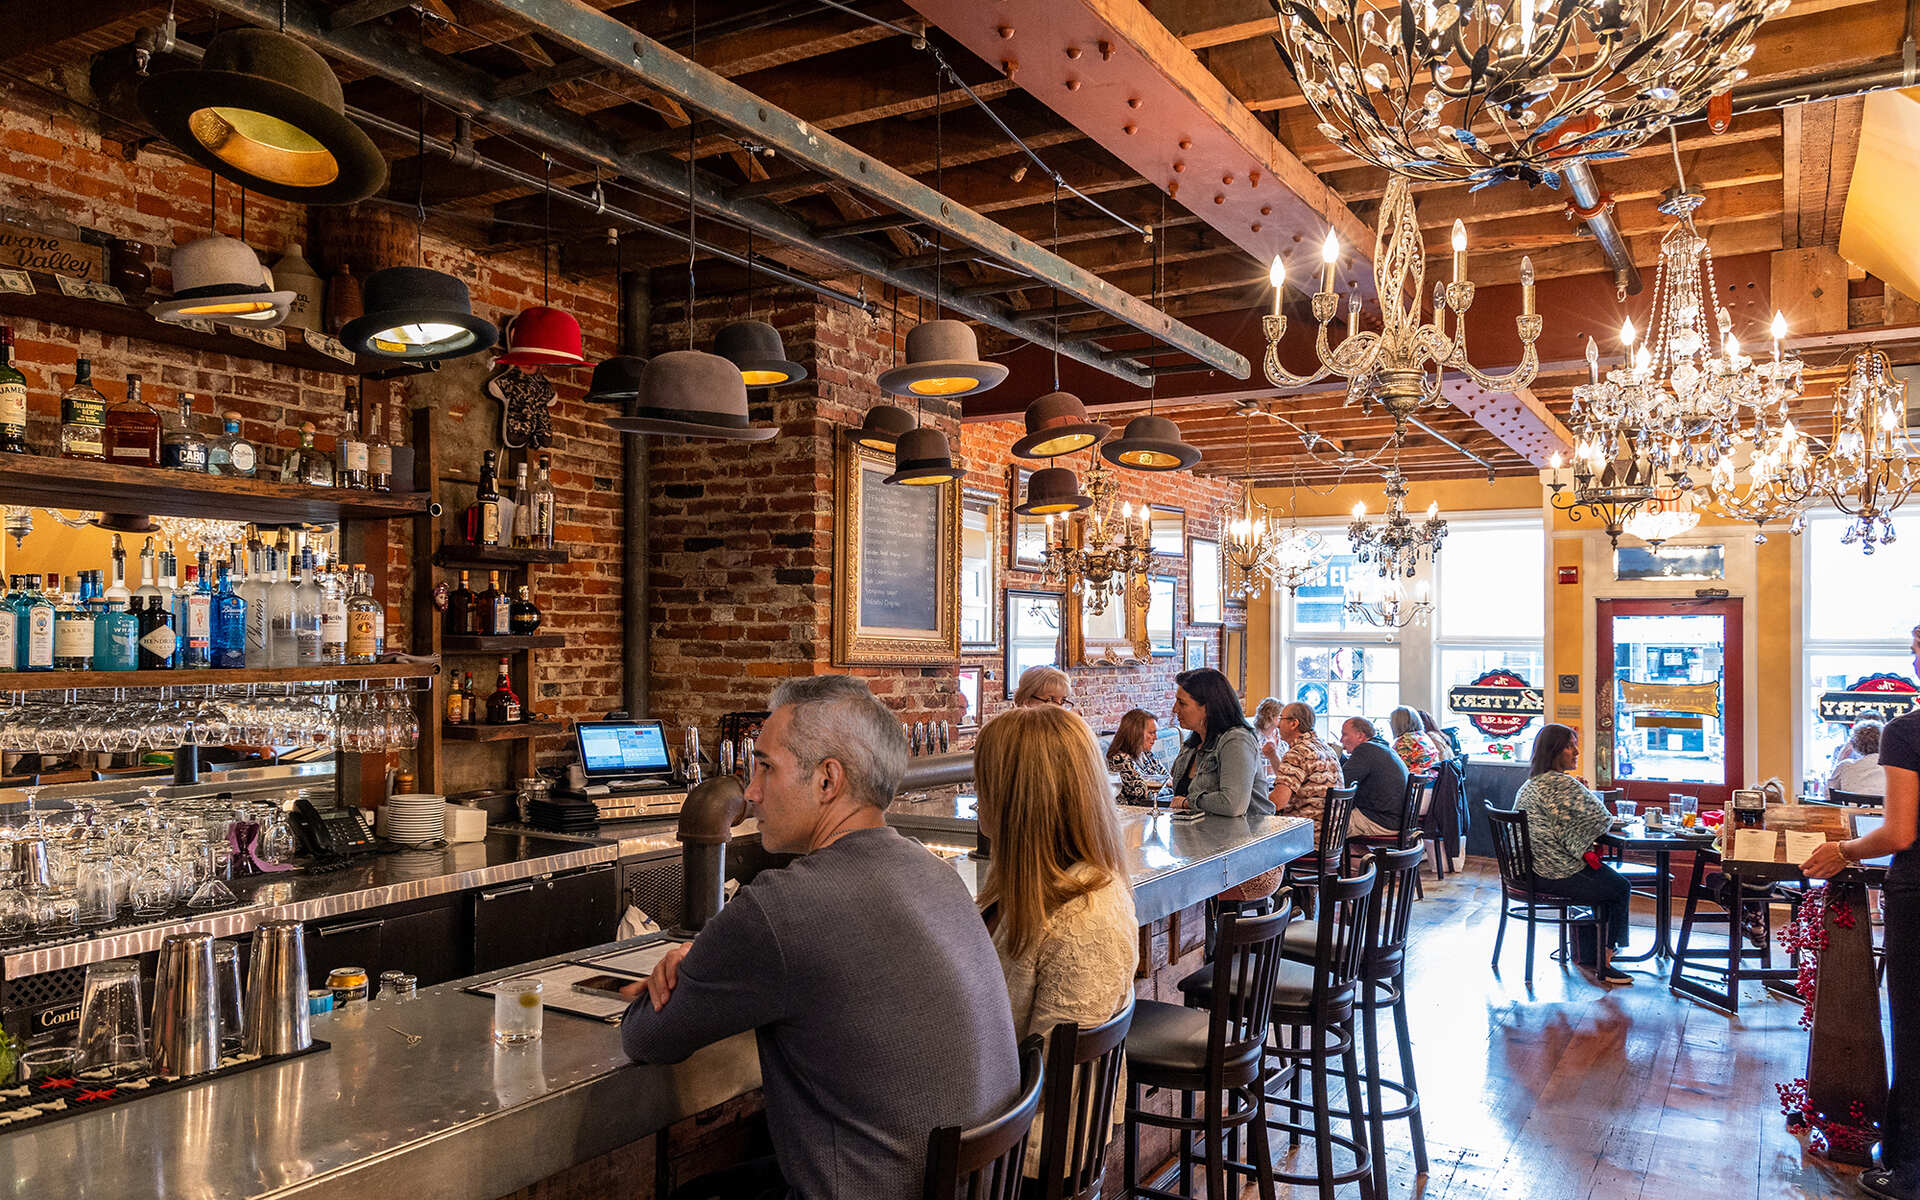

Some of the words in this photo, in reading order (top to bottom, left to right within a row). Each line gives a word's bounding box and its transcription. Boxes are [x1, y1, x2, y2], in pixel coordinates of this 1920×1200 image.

[0, 234, 60, 252] ware
[12, 248, 92, 279] Valley
[0, 386, 27, 395] JAMES
[179, 450, 206, 464] CABO
[40, 1006, 80, 1027] Conti
